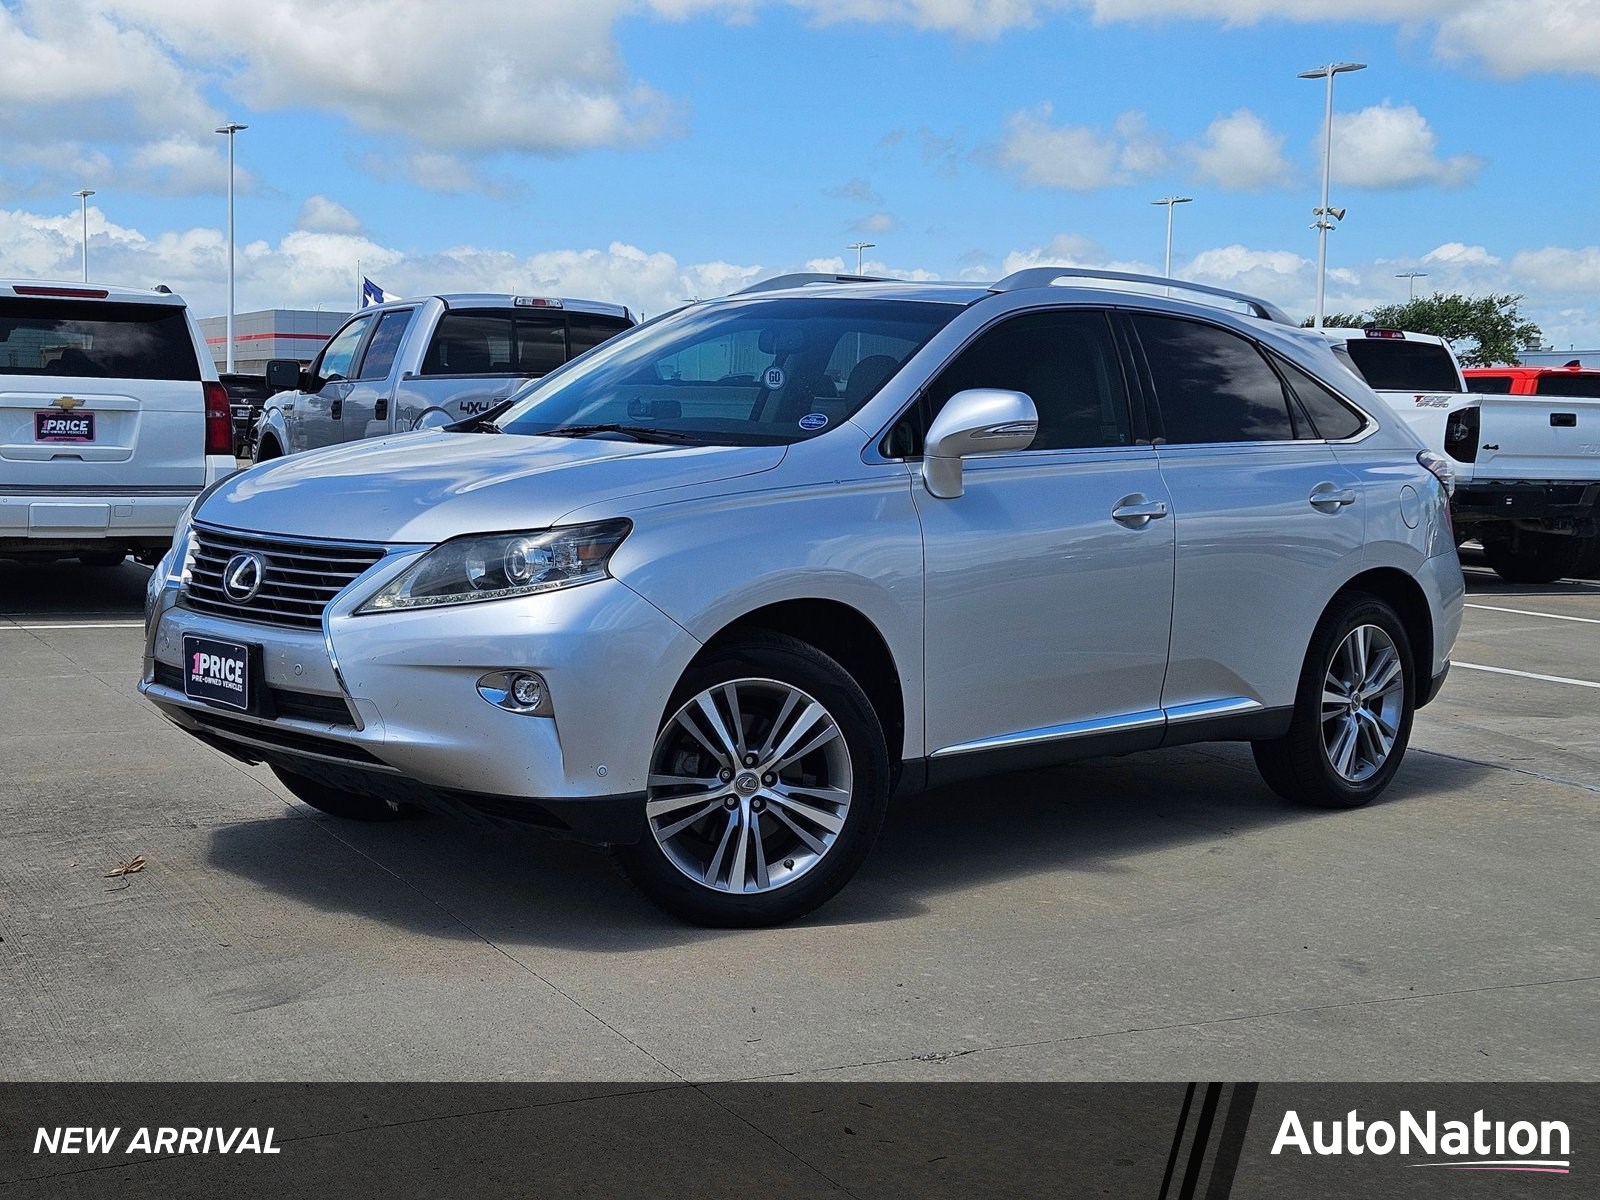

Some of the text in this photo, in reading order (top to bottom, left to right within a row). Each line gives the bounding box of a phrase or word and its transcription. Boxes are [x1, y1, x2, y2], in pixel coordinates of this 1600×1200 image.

[768, 371, 781, 382] GO
[42, 420, 89, 431] 1PRICE
[192, 652, 244, 684] 1PRICE
[191, 674, 243, 692] PRE-OWNED VEHICLES
